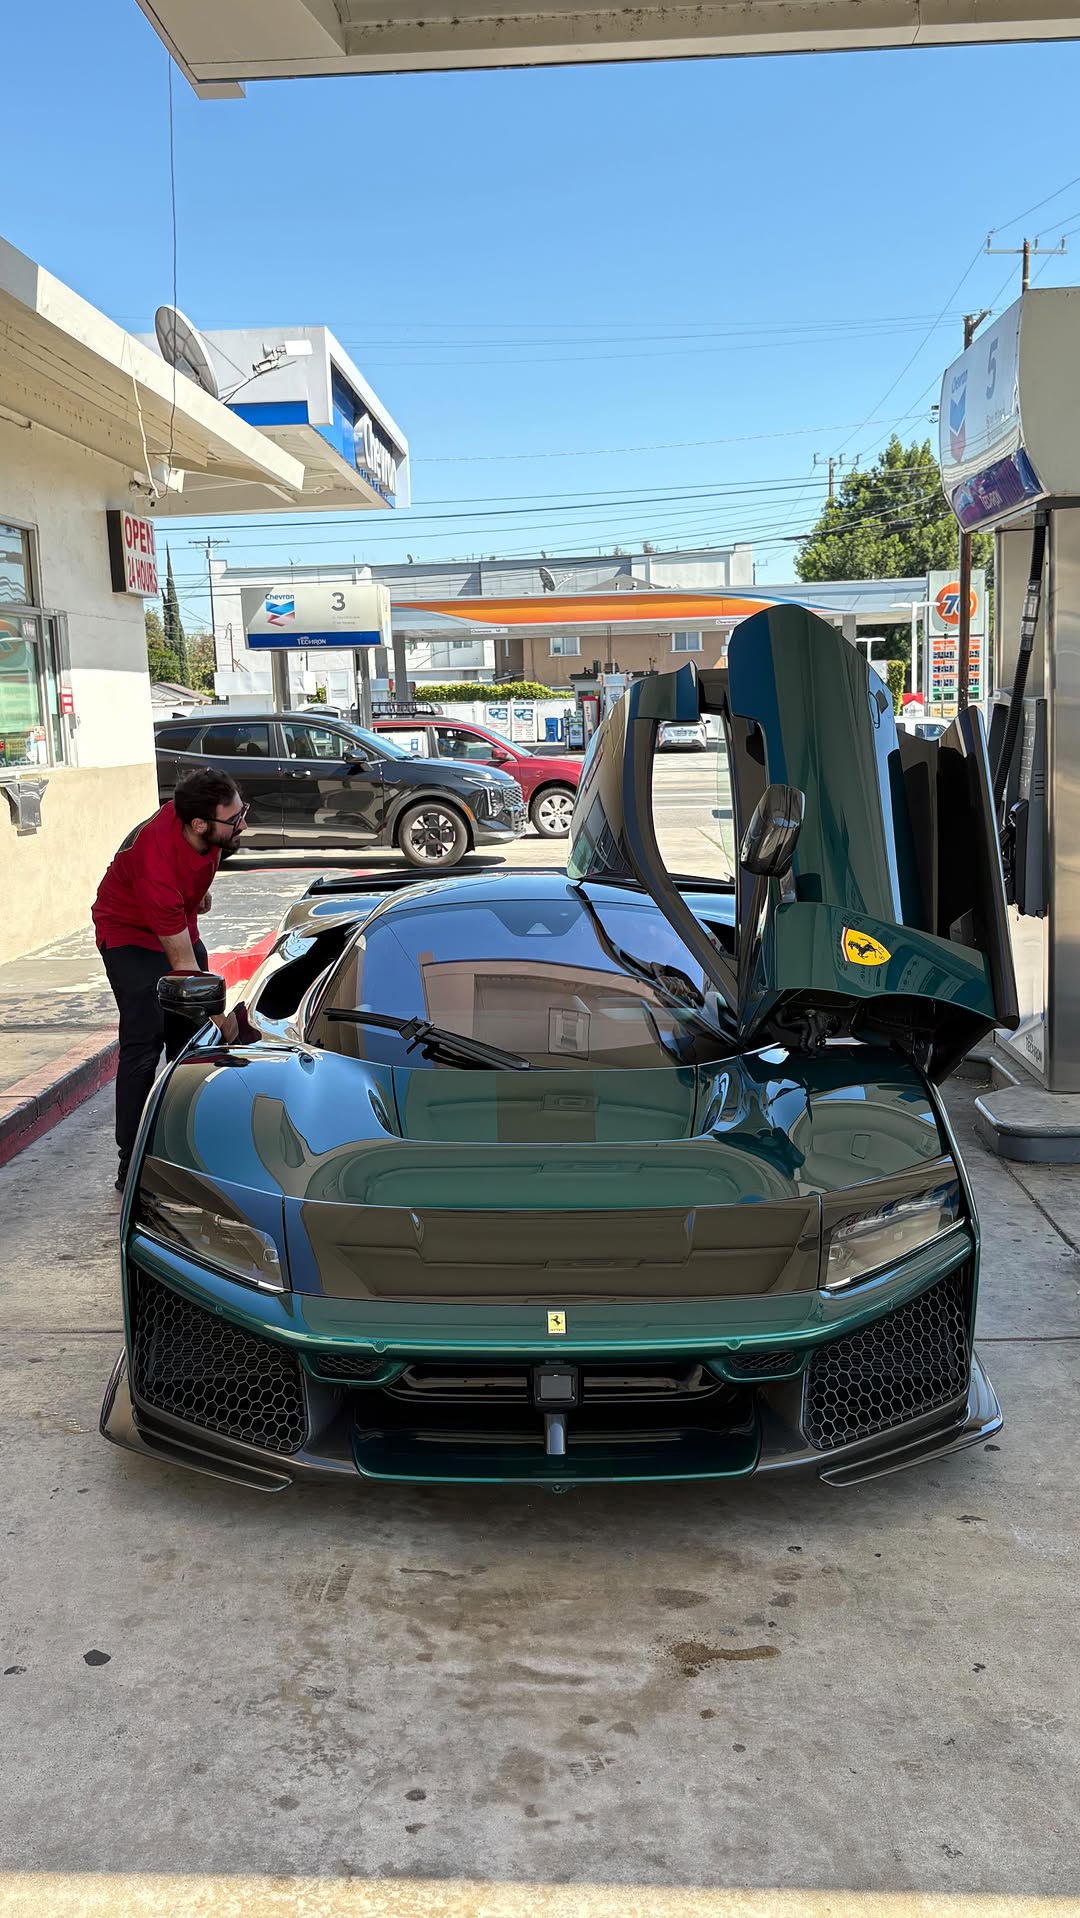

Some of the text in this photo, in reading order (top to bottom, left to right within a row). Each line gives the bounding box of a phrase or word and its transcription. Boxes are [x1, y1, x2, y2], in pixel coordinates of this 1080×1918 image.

[985, 337, 999, 400] 5
[124, 515, 155, 556] OPEN
[135, 558, 158, 595] HOURS
[331, 592, 346, 611] 3
